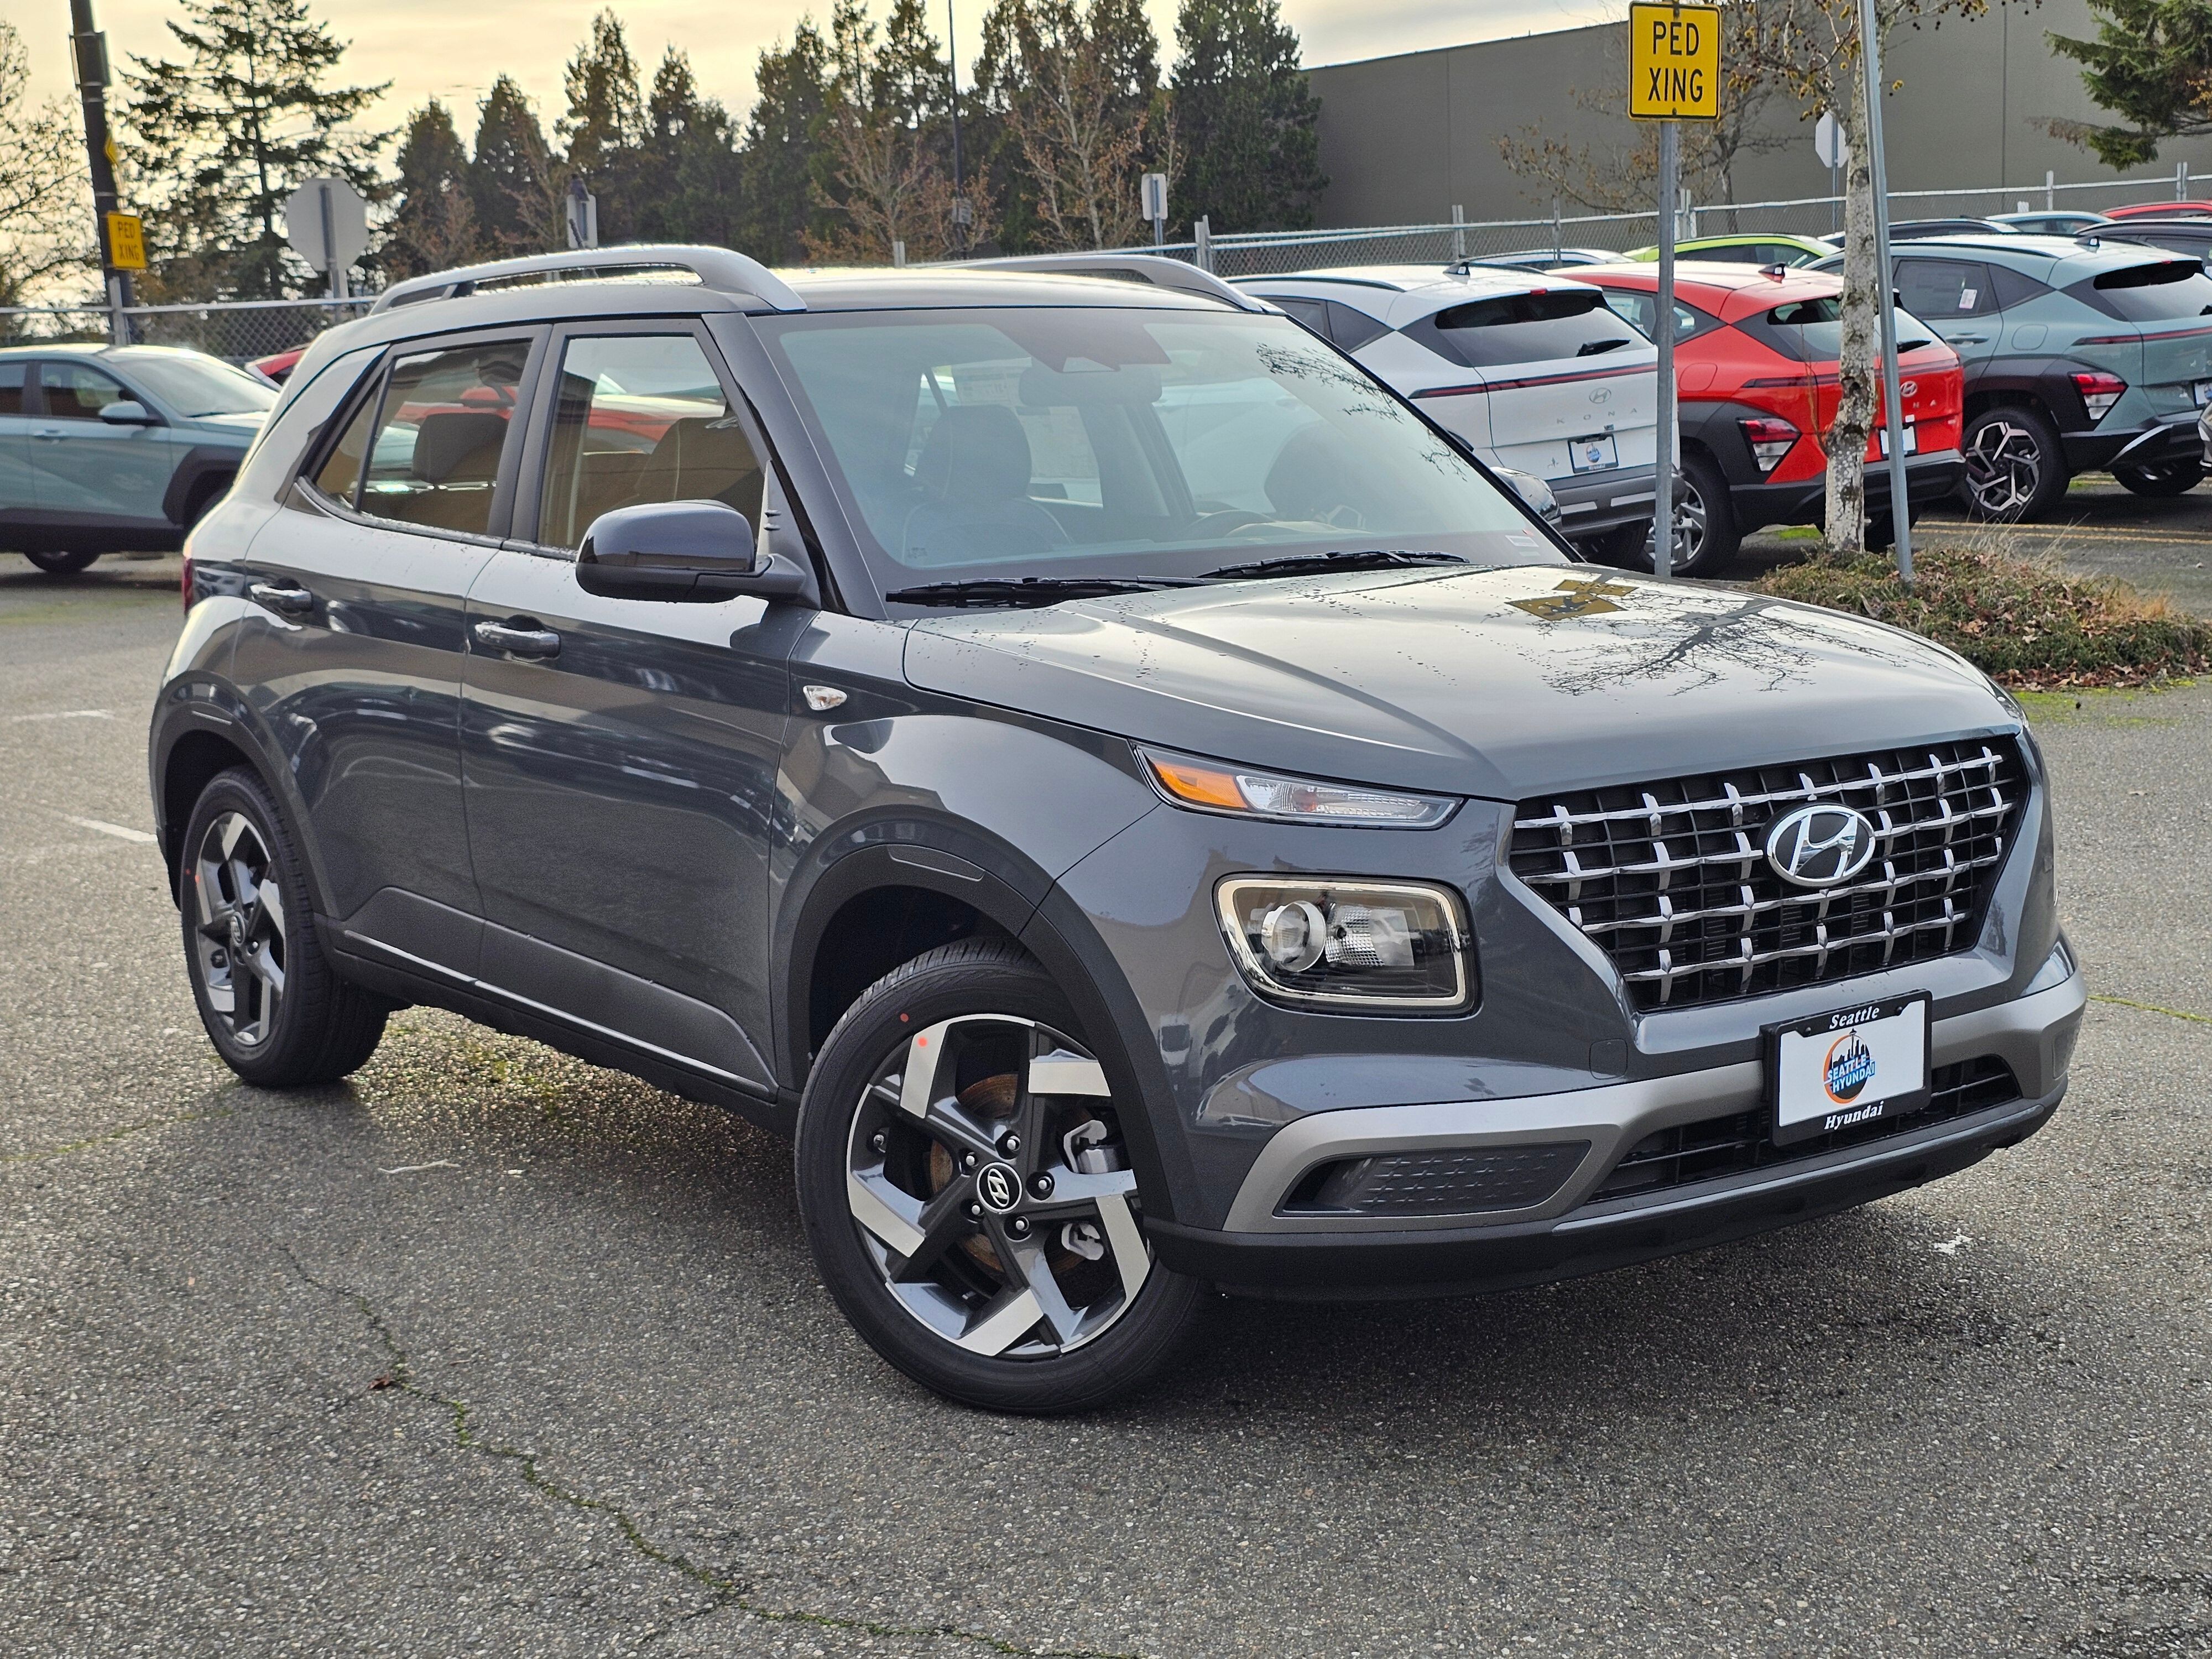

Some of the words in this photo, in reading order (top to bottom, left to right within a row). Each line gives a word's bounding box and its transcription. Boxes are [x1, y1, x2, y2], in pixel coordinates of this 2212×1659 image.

[1653, 20, 1699, 56] PED
[1647, 67, 1703, 103] XING
[117, 221, 135, 239] PED
[119, 243, 140, 262] XING
[1556, 408, 1637, 424] KONA
[1829, 1005, 1880, 1030] Seattle
[1827, 1053, 1867, 1082] SEATTLE
[1833, 1061, 1876, 1093] HYUNDAI
[1824, 1100, 1885, 1130] Hyundai
